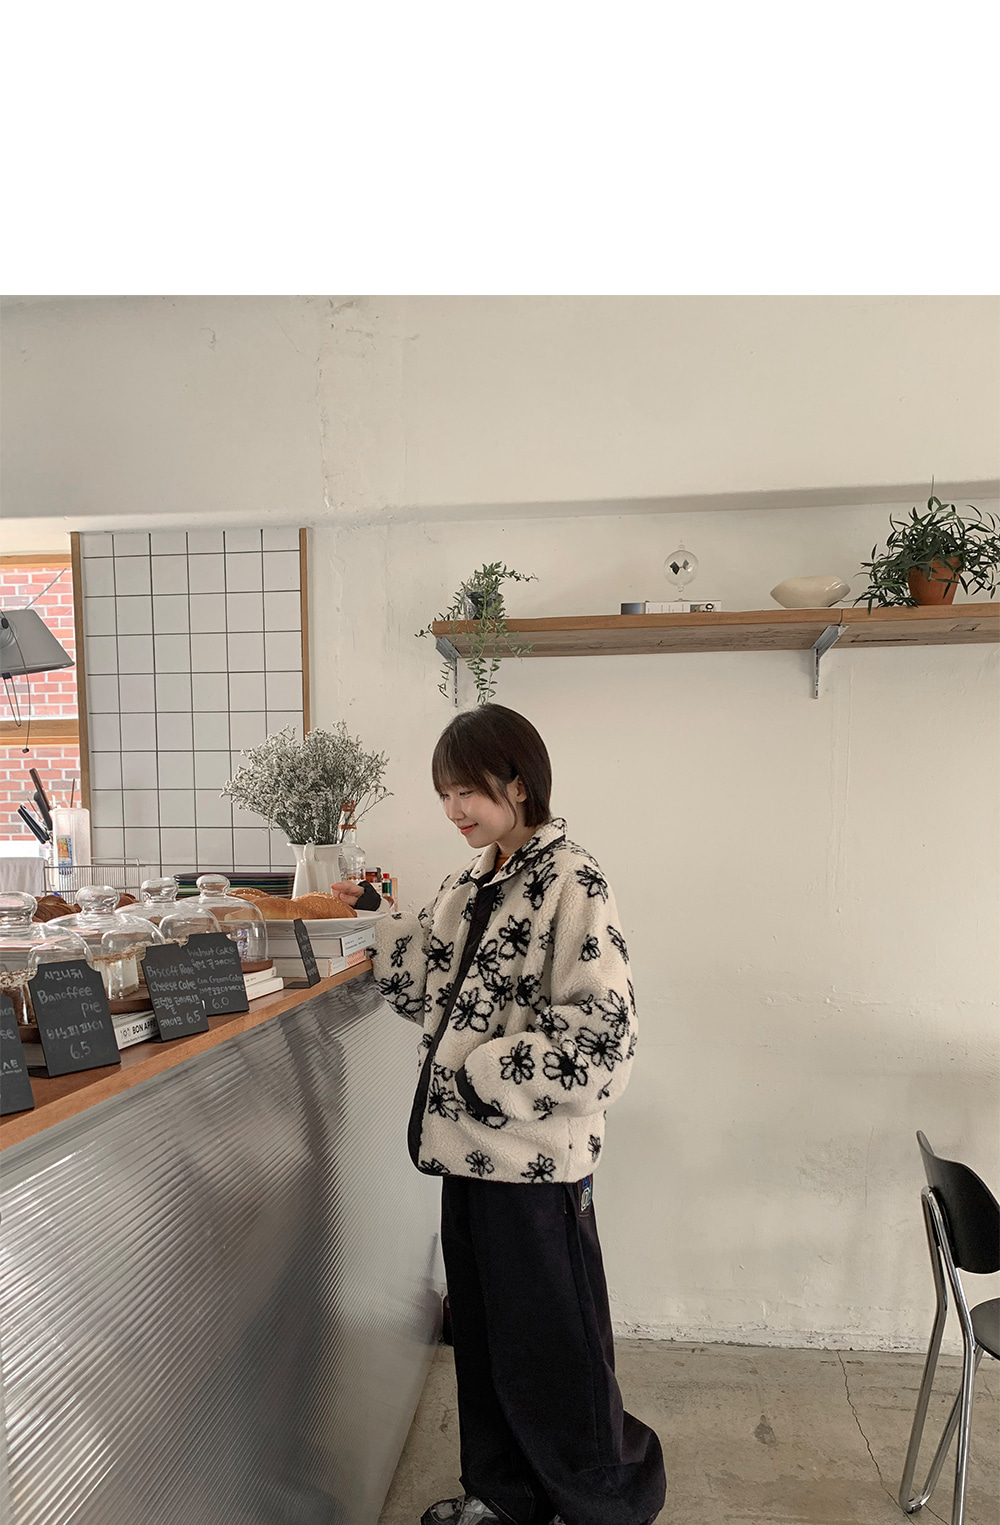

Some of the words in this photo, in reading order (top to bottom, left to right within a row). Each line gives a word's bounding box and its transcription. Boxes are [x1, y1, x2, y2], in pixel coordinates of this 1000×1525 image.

[146, 965, 179, 978] Biscoff
[150, 981, 178, 992] Cheese
[178, 980, 198, 991] Cake
[37, 986, 93, 1004] Banoffee
[81, 1001, 102, 1018] pie
[211, 997, 230, 1009] 6.0
[186, 1010, 201, 1024] 6.5
[132, 1022, 144, 1034] BON
[70, 1041, 91, 1060] 6.5
